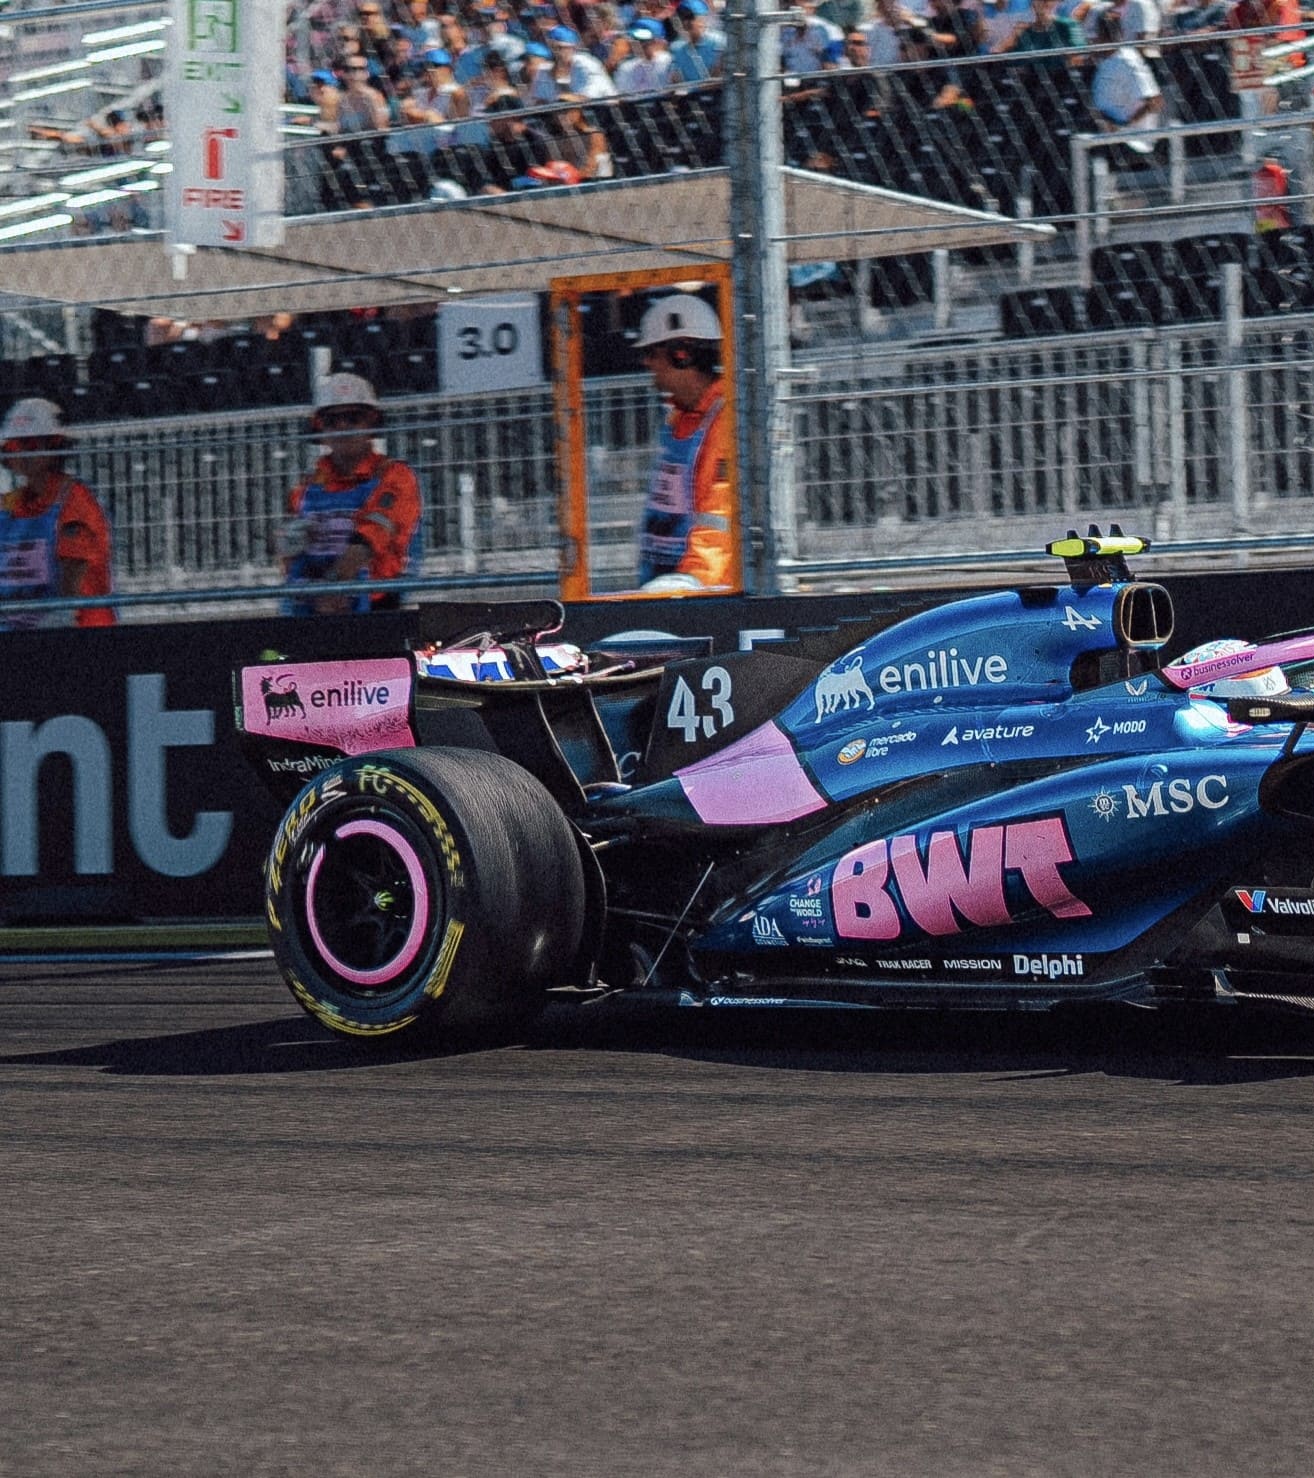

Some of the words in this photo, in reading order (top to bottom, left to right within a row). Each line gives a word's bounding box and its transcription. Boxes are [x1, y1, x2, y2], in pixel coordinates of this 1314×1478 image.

[182, 187, 245, 210] FIRE
[457, 322, 518, 360] 3.0
[879, 648, 1008, 694] enilive
[1193, 652, 1255, 677] businessolver
[310, 679, 390, 708] enilive
[667, 665, 735, 743] 43
[869, 731, 917, 747] mercado
[961, 723, 1035, 742] avature
[1112, 720, 1146, 735] MODO
[865, 746, 889, 759] libre
[1121, 774, 1230, 819] MSC
[831, 817, 1093, 941] BWT
[789, 899, 822, 909] CHANGE
[796, 908, 823, 918] WORLD
[901, 959, 933, 969] RACER
[943, 959, 1002, 970] MISSION
[1013, 954, 1084, 980] Delphi
